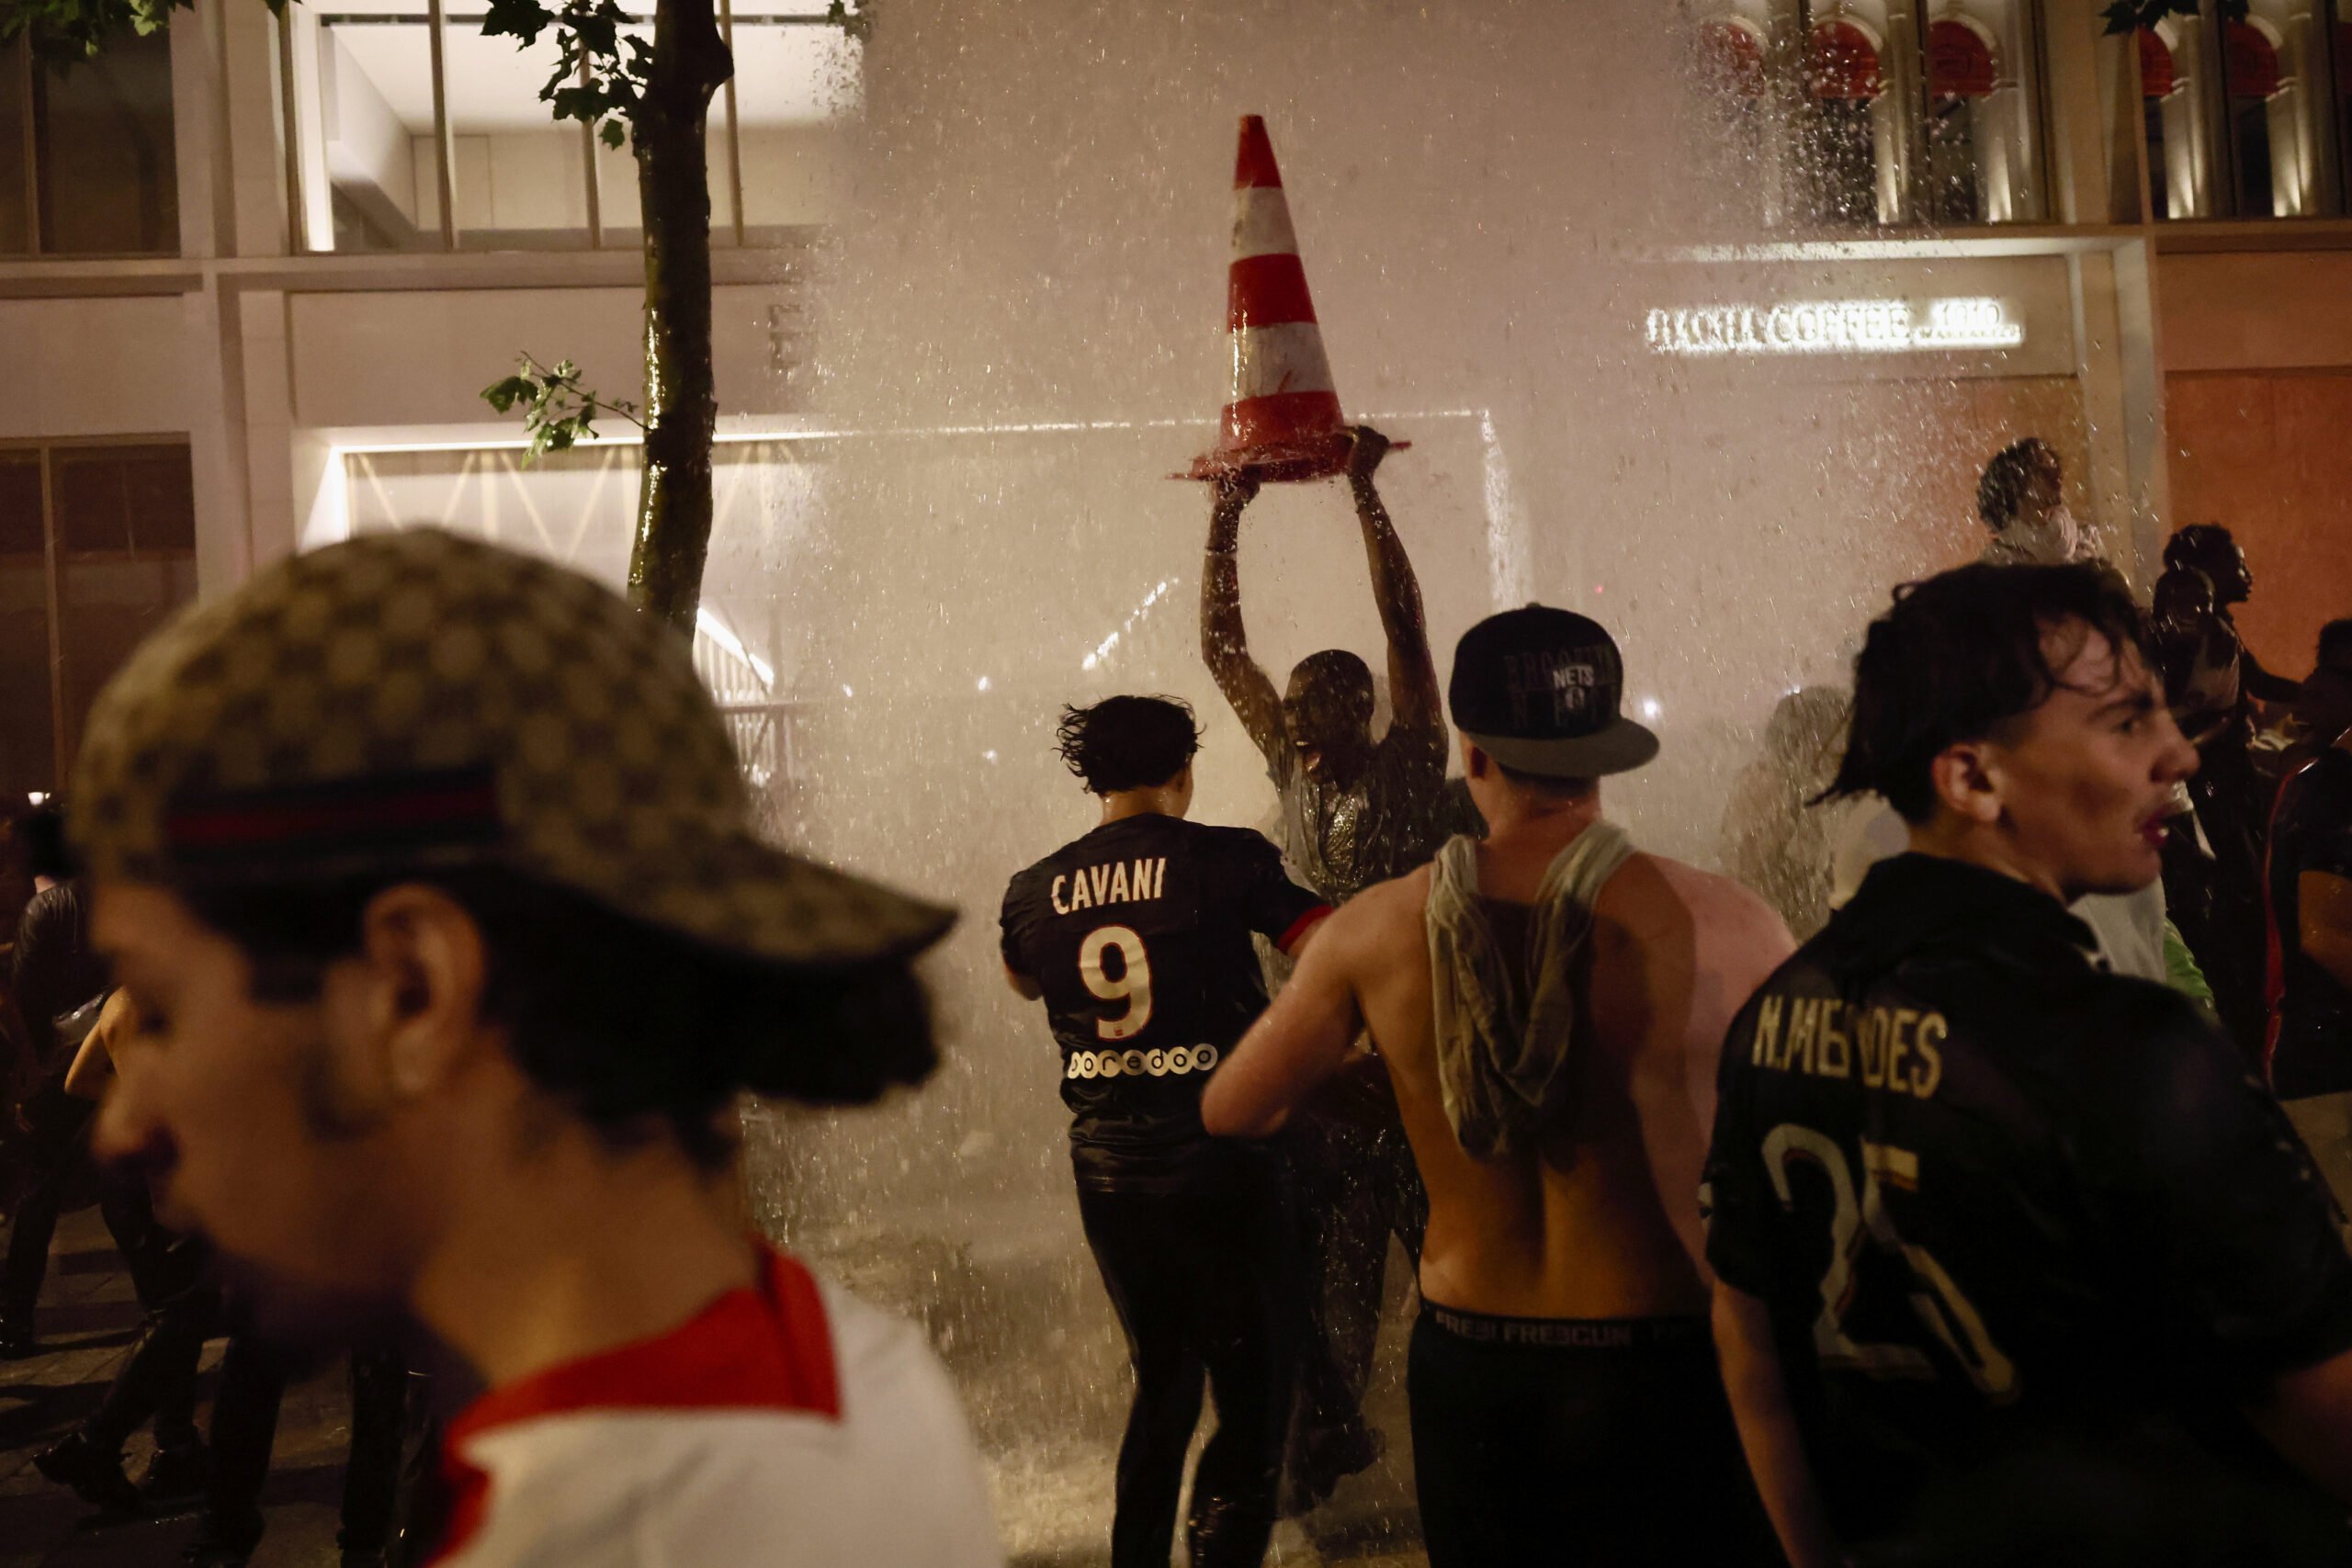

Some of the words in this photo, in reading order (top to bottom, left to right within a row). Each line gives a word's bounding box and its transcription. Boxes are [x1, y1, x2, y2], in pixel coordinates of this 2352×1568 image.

[1765, 301, 1911, 347] COFFEE
[1553, 664, 1596, 689] NETS
[1051, 857, 1167, 915] CAVANI
[1079, 923, 1153, 1042] 9
